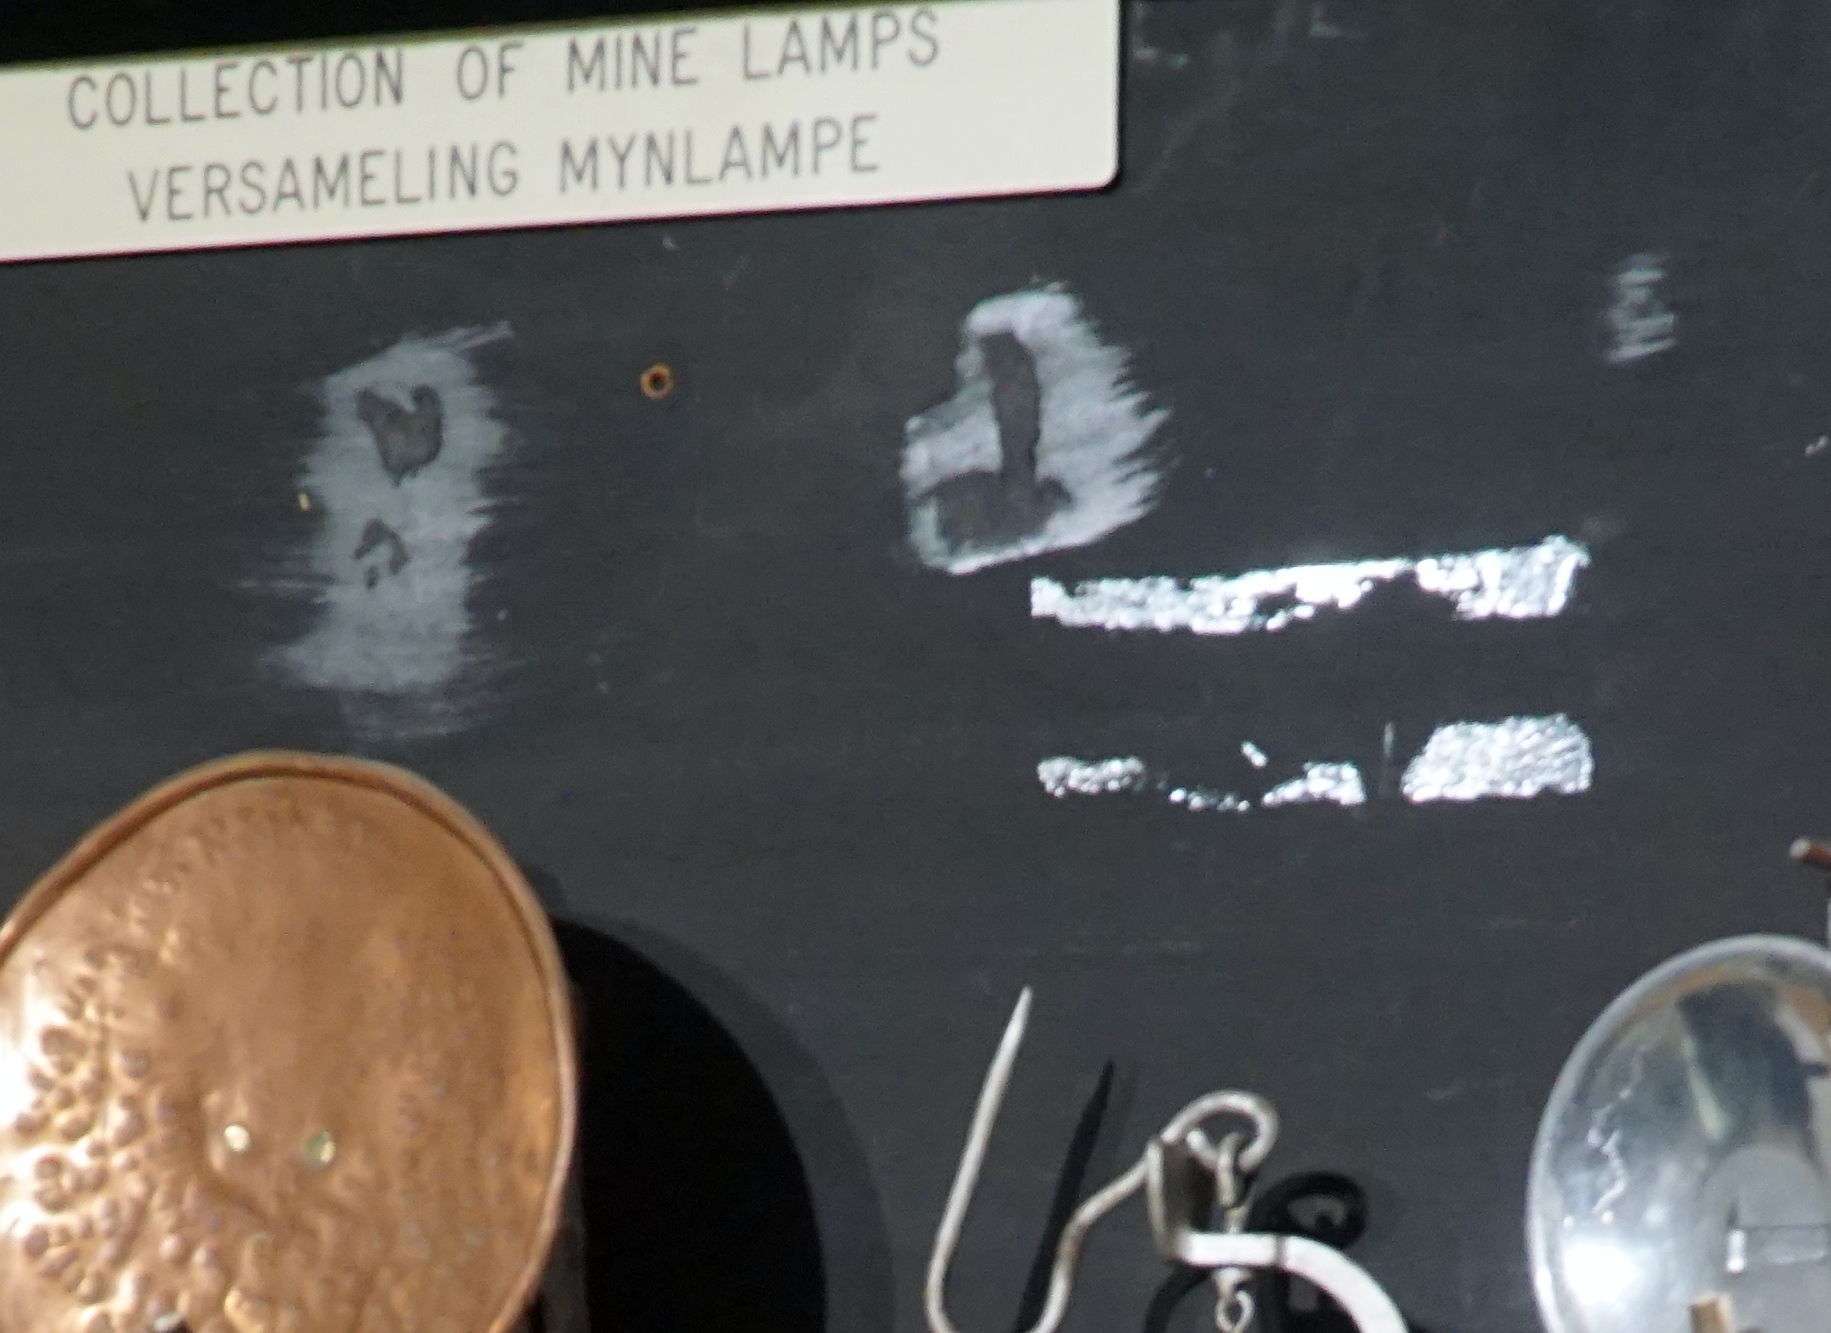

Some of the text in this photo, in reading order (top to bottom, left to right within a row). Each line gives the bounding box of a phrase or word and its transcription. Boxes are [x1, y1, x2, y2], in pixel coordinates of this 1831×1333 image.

[67, 9, 942, 131] COLLECTION OF MINE LAMPS
[127, 113, 881, 224] VERSAMELING MYNLAMPE
